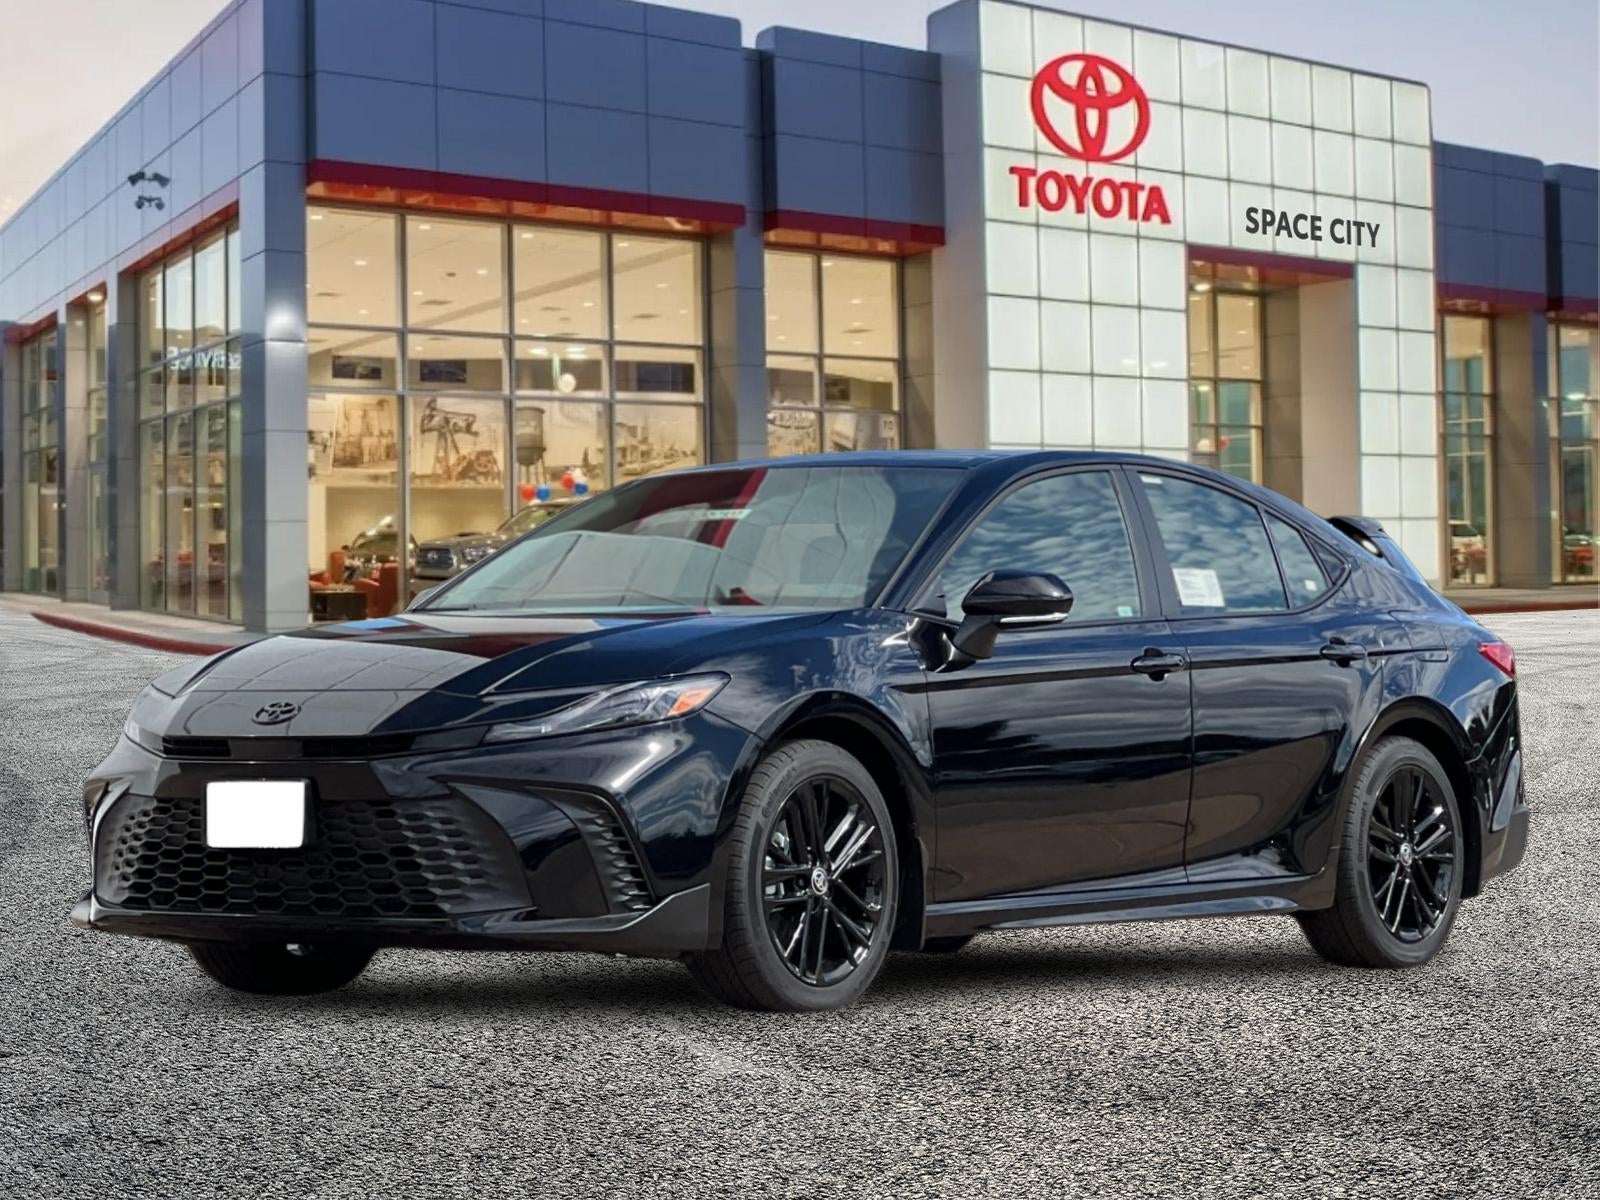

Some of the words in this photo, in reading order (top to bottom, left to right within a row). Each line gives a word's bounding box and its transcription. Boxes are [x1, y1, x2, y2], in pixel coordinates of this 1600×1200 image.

[1009, 167, 1171, 225] TOYOTA
[1245, 206, 1322, 242] SPACE
[1329, 218, 1380, 248] CITY
